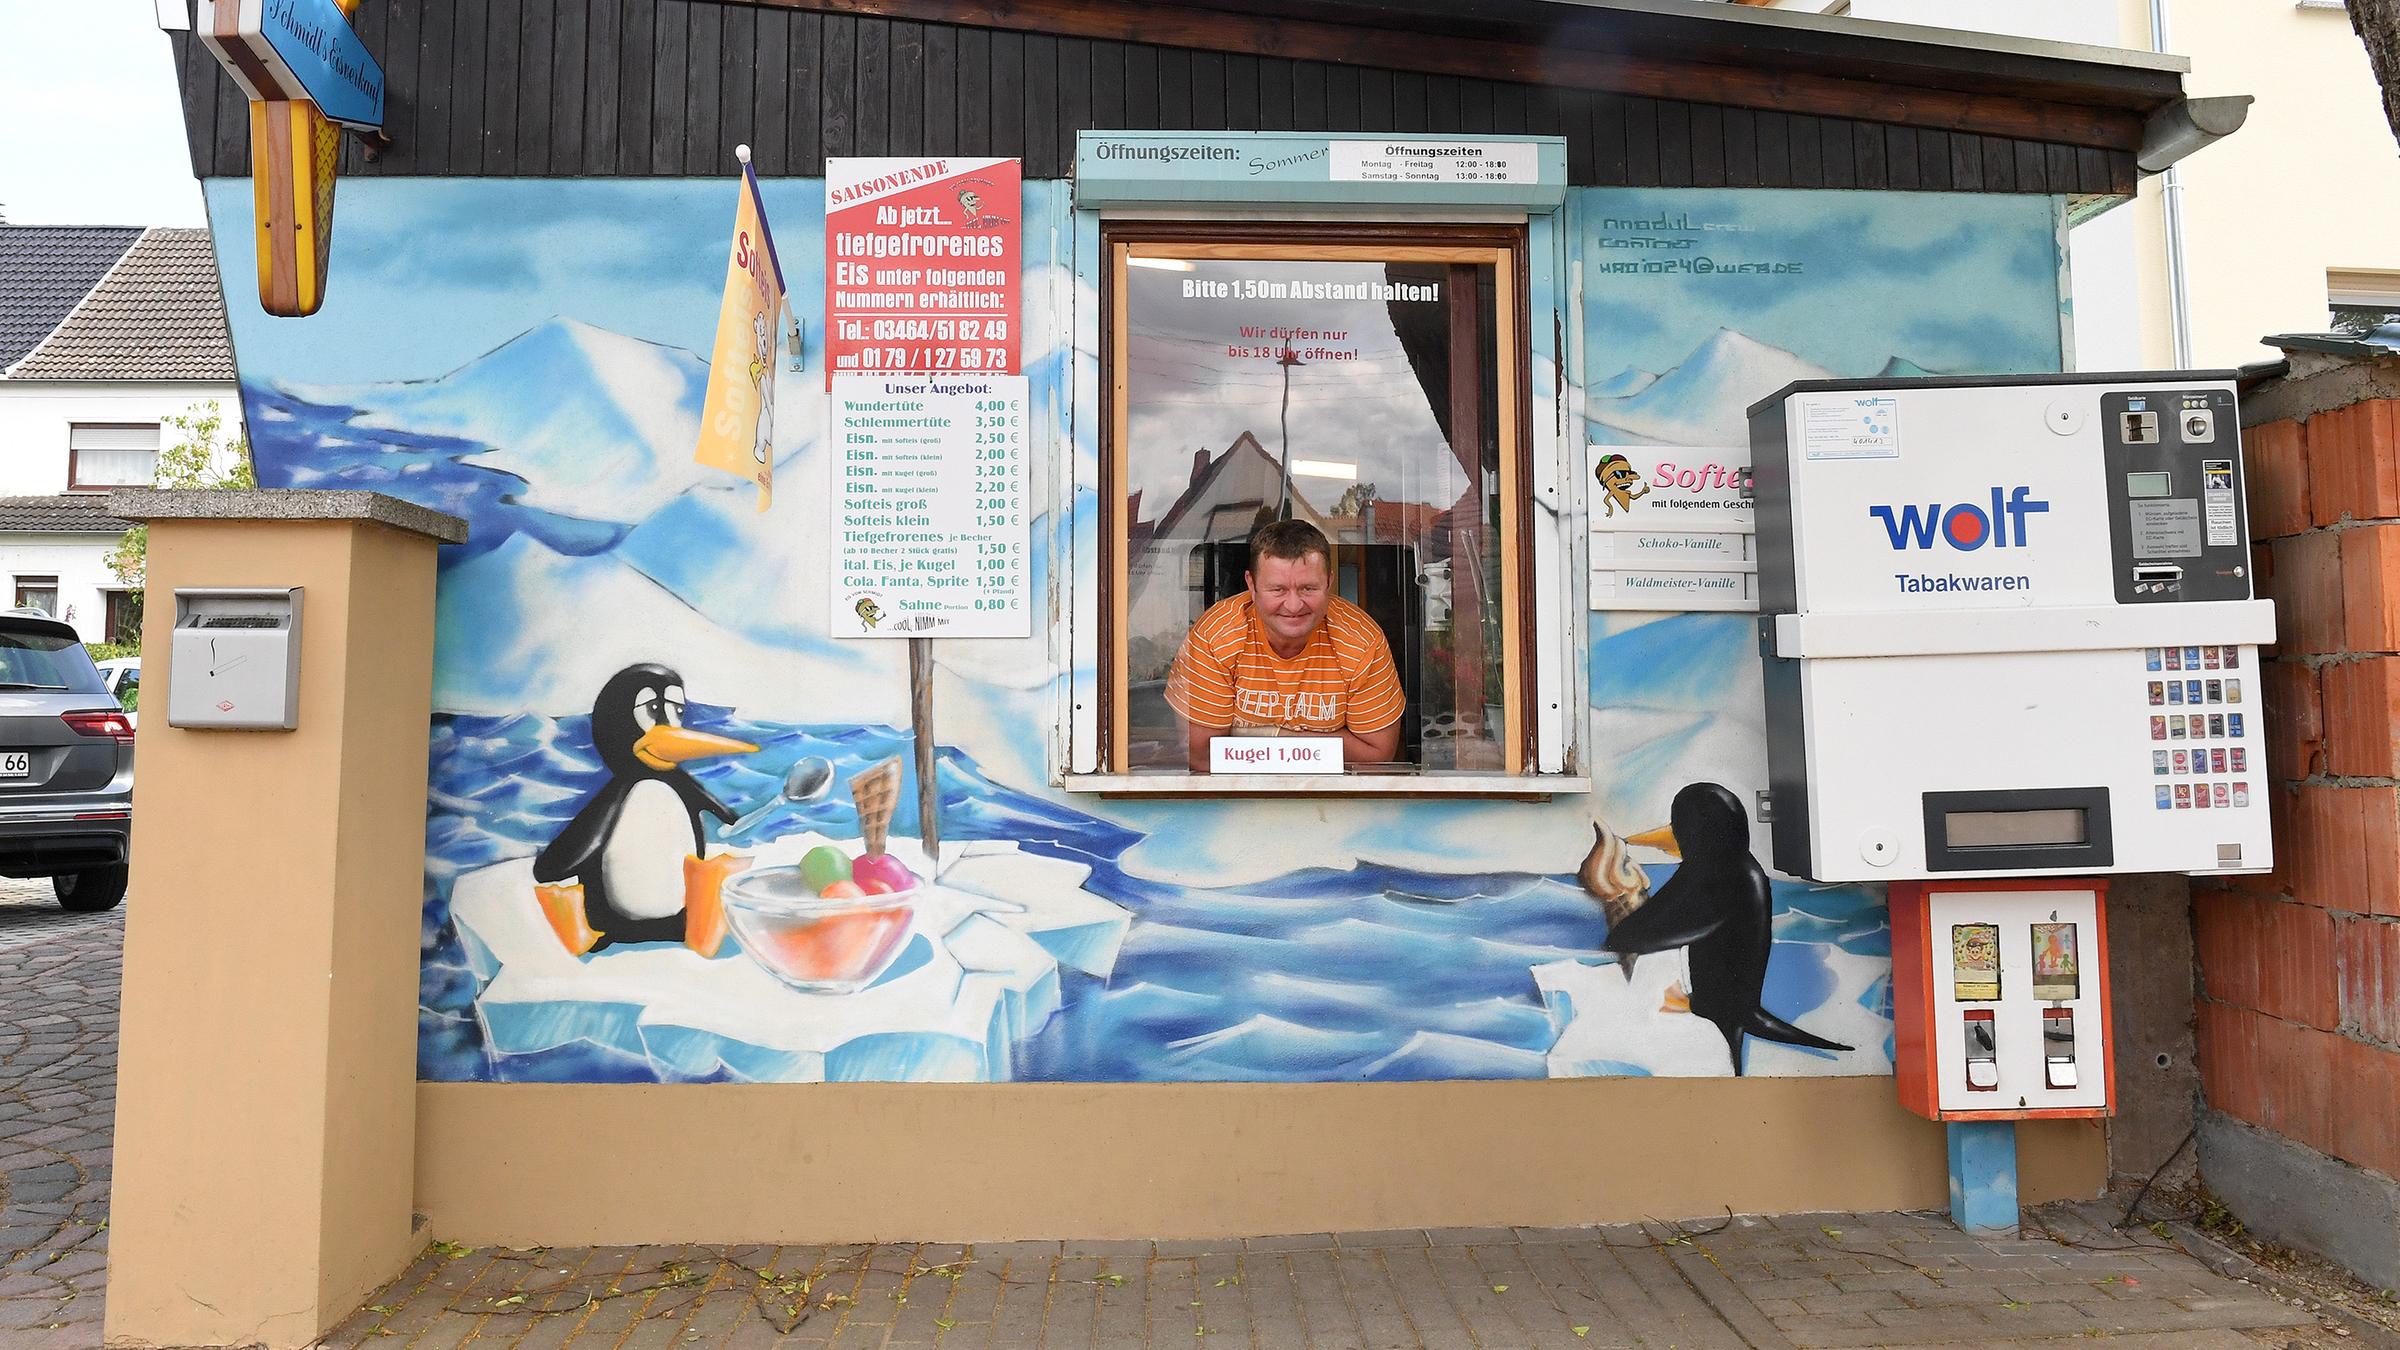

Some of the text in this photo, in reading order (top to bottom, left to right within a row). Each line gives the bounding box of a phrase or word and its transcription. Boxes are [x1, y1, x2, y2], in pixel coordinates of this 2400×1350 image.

[1385, 144, 1483, 157] Öffnungszeiten
[1096, 142, 1329, 175] Öffnungszeiten: Sommer
[1361, 160, 1392, 169] Montag
[1404, 160, 1434, 169] Freitag
[831, 160, 949, 205] SAISONENDE
[1361, 172, 1397, 181] Samstag
[1405, 172, 1440, 181] Sonntag
[876, 206, 897, 224] Ab
[836, 232, 1004, 258] tiefgefrorenes
[836, 262, 1006, 287] Eis unter folgenden
[1182, 279, 1439, 302] Bitte 1,50m Abstand halten!
[836, 289, 1004, 308] Nummern erhältlich:
[874, 320, 955, 341] 03464/51
[959, 320, 980, 341] 82
[984, 320, 1008, 341] 49
[1239, 326, 1348, 340] Wir dürfen nur
[836, 353, 859, 368] und
[863, 347, 881, 368] 01
[885, 347, 906, 368] 79
[935, 347, 957, 368] 27
[960, 347, 981, 368] 59
[986, 347, 1008, 368] 73
[1228, 345, 1359, 360] bis 18 Uhr öffnen!
[885, 384, 992, 396] Unser Angebot:
[845, 401, 924, 411] Wundertüte
[975, 401, 1005, 412] 4,00
[844, 417, 951, 428] Schlemmertüte
[975, 417, 1005, 428] 3,50
[846, 433, 877, 444] Eisn.
[975, 433, 1005, 444] 2,50
[846, 449, 878, 461] Eisn.
[975, 449, 1005, 461] 2,00
[846, 466, 877, 476] Eisn.
[975, 466, 1005, 477] 3,20
[1652, 463, 1741, 493] Softe
[846, 482, 877, 493] Eisn.
[975, 482, 1005, 494] 2,20
[844, 499, 892, 510] Softeis
[896, 499, 928, 512] groß
[975, 498, 1005, 510] 2,00
[1652, 499, 1667, 508] mit
[1670, 499, 1720, 510] folgendem
[844, 515, 892, 526] Softeis
[896, 515, 929, 526] klein
[976, 515, 1005, 527] 1,50
[1869, 486, 2050, 551] wolf
[843, 531, 944, 544] Tiefgefrorenes
[949, 534, 958, 542] je
[1638, 537, 1722, 550] Schoko-Vanille
[932, 547, 958, 555] gratis)
[977, 543, 1006, 555] 1,50
[844, 559, 869, 570] ital.
[899, 559, 912, 572] je
[917, 559, 955, 572] Kugel
[976, 559, 1005, 571] 1,00
[881, 576, 923, 588] Fanta,
[927, 575, 969, 588] Sprite
[976, 575, 1005, 588] 1,50
[1625, 577, 1736, 588] Waldmeister-Vanille
[1894, 573, 2030, 593] Tabakwaren
[899, 599, 942, 610] Sahne
[974, 599, 1005, 611] 0,80
[915, 616, 935, 631] NIMM
[1284, 691, 1336, 721] CALM
[1224, 747, 1270, 763] Kugel
[5, 755, 27, 771] 66
